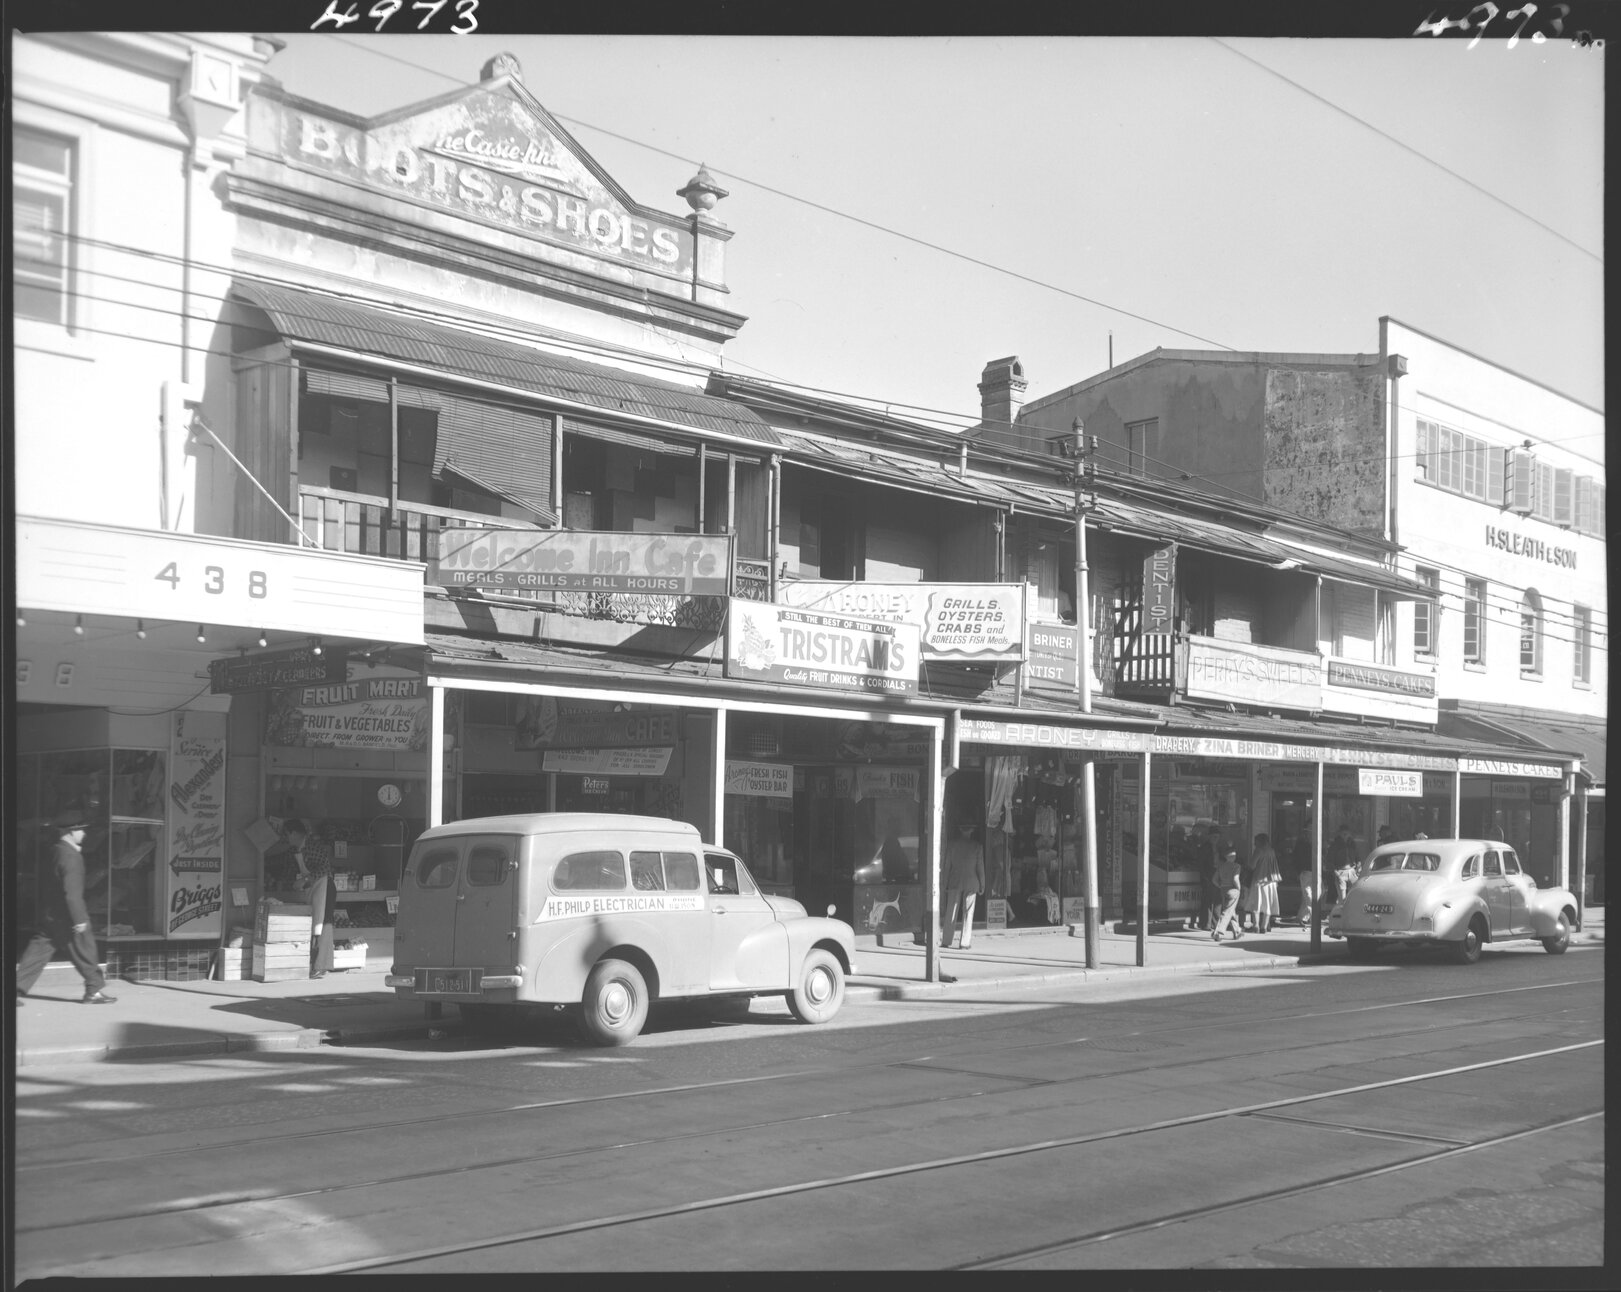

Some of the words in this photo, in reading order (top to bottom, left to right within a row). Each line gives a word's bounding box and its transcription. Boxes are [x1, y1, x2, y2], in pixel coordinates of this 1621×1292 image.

[310, 0, 480, 34] 4973
[300, 117, 493, 203] BOOTS
[498, 186, 519, 213] &
[521, 186, 680, 264] SHOES
[446, 532, 574, 571] Welcome
[589, 537, 630, 573] Inn
[645, 539, 716, 592] Cafe
[1554, 546, 1578, 570] SON
[453, 571, 504, 584] MEALS
[517, 574, 567, 586] GRILLS
[574, 578, 587, 587] at
[593, 578, 618, 587] ALL
[627, 577, 679, 590] HOURS
[784, 612, 804, 621] STILL
[806, 615, 818, 624] THE
[823, 617, 841, 627] BEST
[844, 620, 853, 629] OF
[856, 622, 872, 631] THEM
[937, 624, 982, 634] CRABS
[987, 624, 1005, 635] and
[931, 635, 967, 644] BONELESS
[969, 636, 985, 645] FISH
[1034, 633, 1073, 650] BRINER
[780, 627, 905, 672] TRISTRAM'S
[784, 669, 808, 683] Quality
[809, 671, 828, 683] FRUIT
[830, 673, 857, 686] DRINKS
[860, 677, 865, 686] &
[867, 677, 906, 690] CORDIALS
[1028, 665, 1065, 680] NTIST
[1393, 673, 1433, 694] CAKES
[302, 683, 359, 705] FRUIT
[368, 680, 420, 698] MART
[359, 702, 390, 716] Fresh
[391, 704, 416, 719] Daily
[303, 714, 335, 729] FRUIT
[336, 719, 342, 729] &
[344, 716, 410, 732] VEGETABLES
[625, 717, 671, 741] CAFE
[976, 720, 995, 729] FOODS
[333, 733, 353, 741] FROM
[356, 734, 384, 743] GROWER
[1006, 724, 1098, 747] ARONEY
[1205, 739, 1232, 754] ZINA
[1237, 741, 1278, 756] BRINER
[751, 767, 770, 779] FRESH
[773, 769, 788, 780] FISH
[1523, 764, 1560, 777] CAKES
[584, 776, 609, 789] Peters
[750, 780, 773, 791] OYSTER
[774, 780, 788, 792] BAR
[890, 772, 914, 788] FISH
[193, 859, 219, 868] INSIDE
[171, 884, 221, 914] Briggs
[593, 898, 665, 912] ELECTRICIAN
